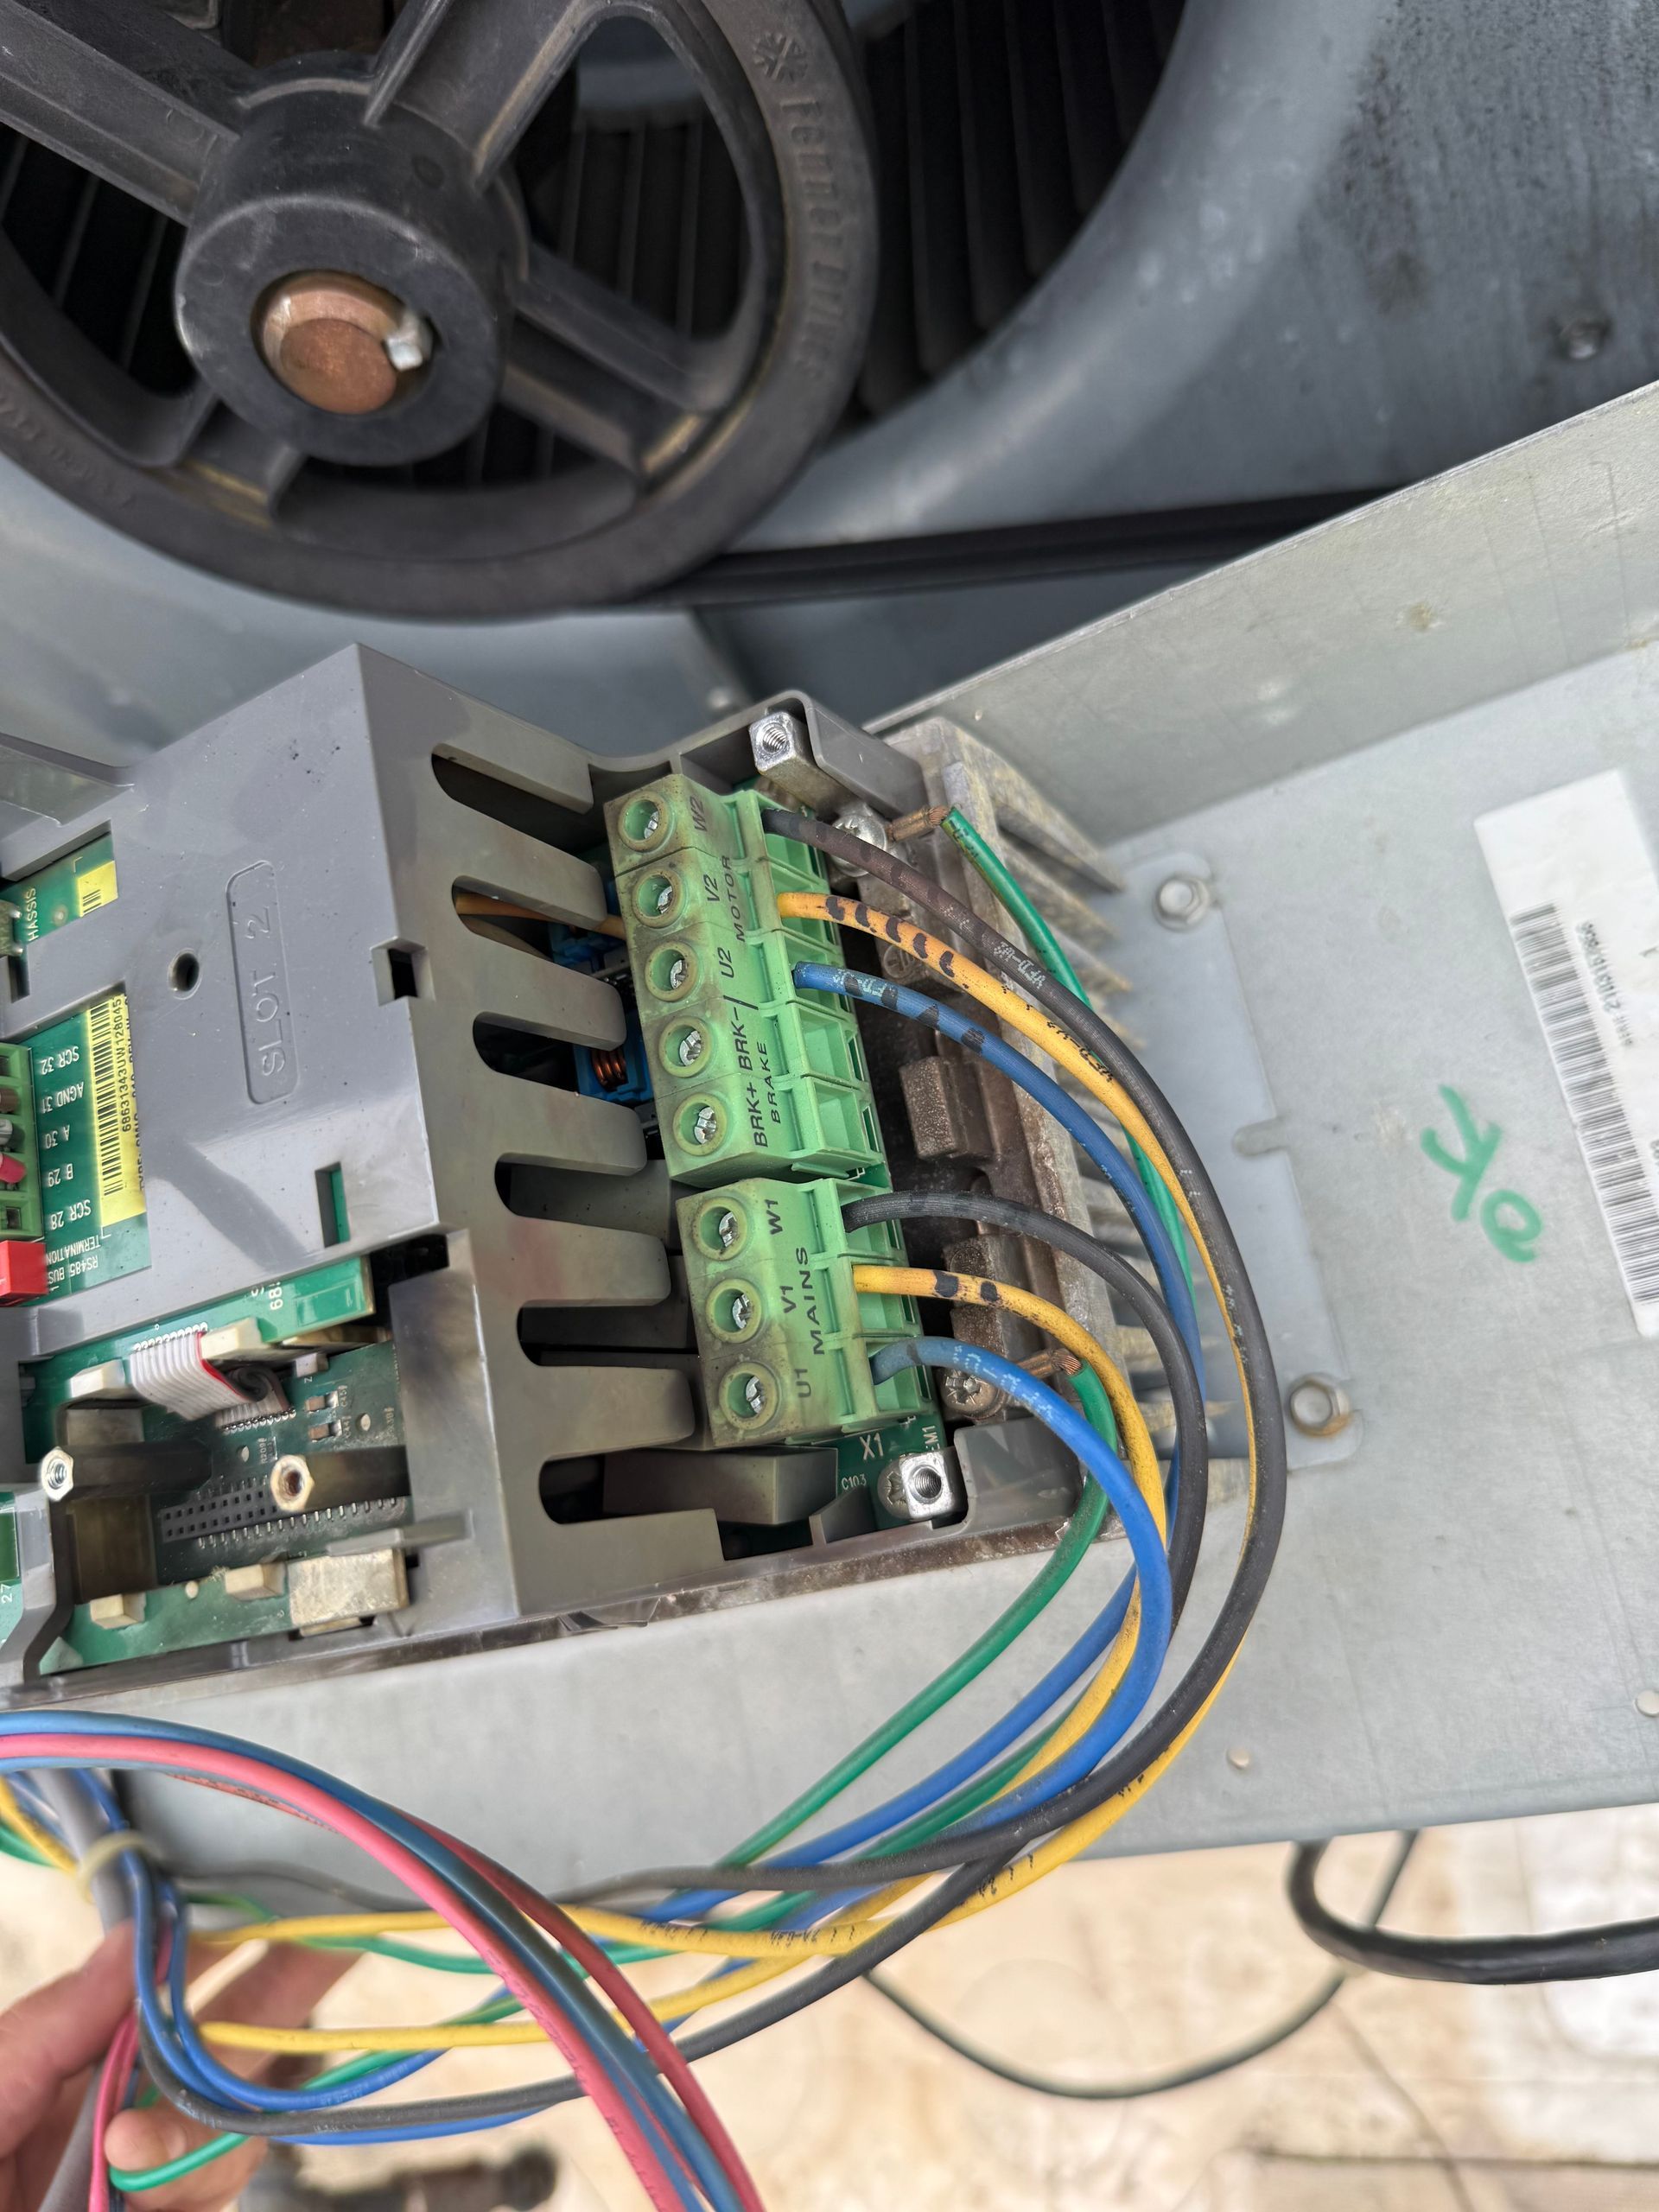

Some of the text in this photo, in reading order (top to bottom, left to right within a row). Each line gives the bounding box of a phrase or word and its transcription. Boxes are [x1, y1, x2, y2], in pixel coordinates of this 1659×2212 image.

[690, 796, 707, 831] W2
[703, 874, 720, 901] V2
[721, 855, 746, 942] MOTOR
[717, 947, 734, 978] U2
[245, 906, 285, 1076] SLOT 2
[733, 1007, 753, 1071] BRK-
[41, 1046, 79, 1075] SCR 32
[112, 995, 131, 1133] 68631343UW128045
[42, 1081, 84, 1114] AGND 31
[757, 1041, 781, 1123] BRAKE
[747, 1083, 769, 1147] BRK+
[45, 1124, 70, 1148] A 30
[48, 1163, 73, 1187] B 29
[1420, 1084, 1544, 1263] OK
[51, 1199, 92, 1230] SCR 28
[765, 1198, 783, 1235] W1
[46, 1235, 101, 1266] TERMINATION
[48, 1255, 99, 1284] RS485 BUS
[268, 1281, 283, 1310] 68
[779, 1285, 798, 1314] V1
[795, 1247, 825, 1355] MAINS
[798, 1368, 812, 1398] U1
[859, 1433, 884, 1460] X1
[842, 1474, 867, 1491] C103
[1, 1584, 12, 1604] 27
